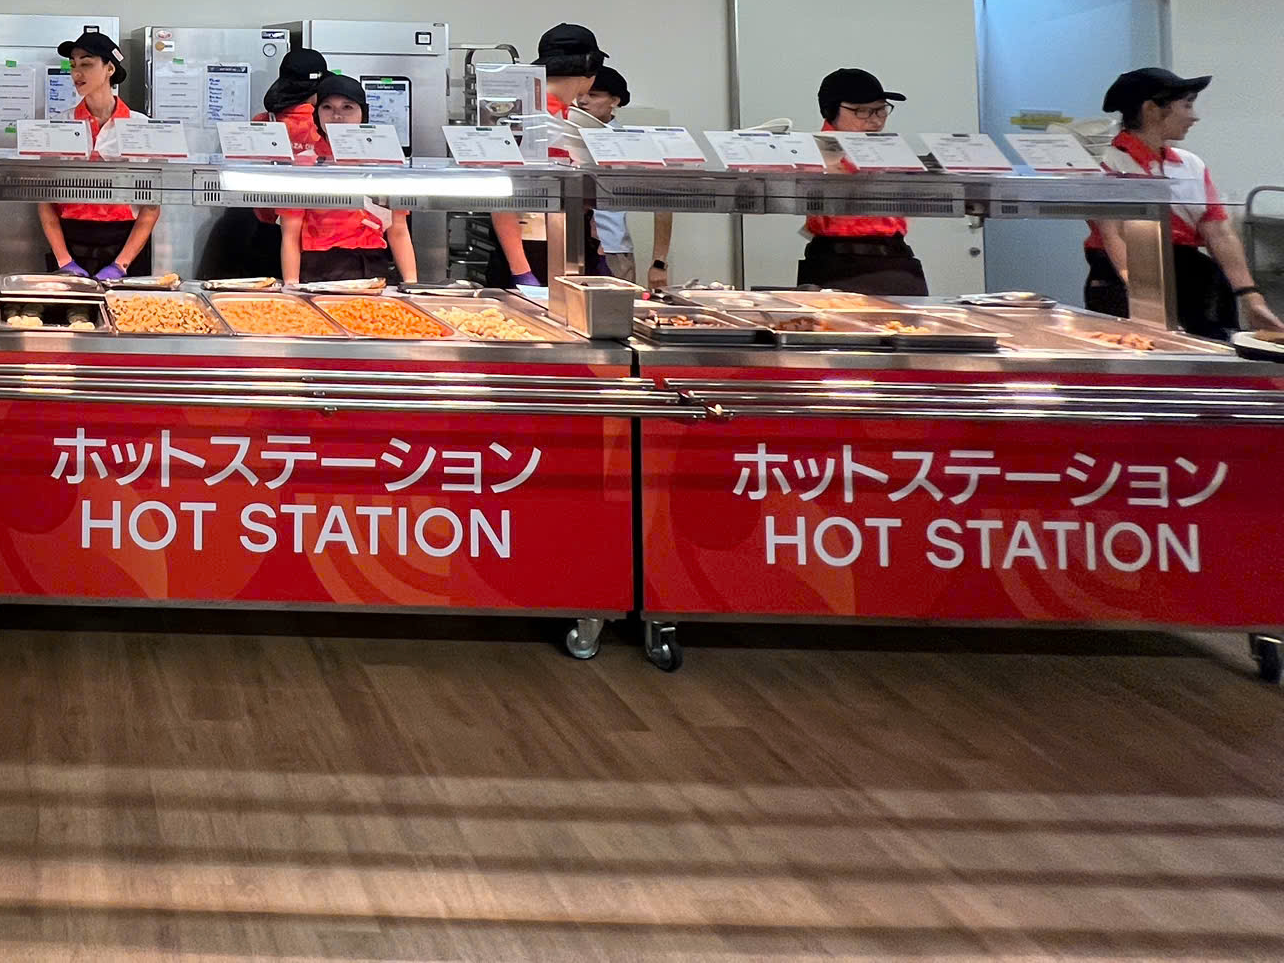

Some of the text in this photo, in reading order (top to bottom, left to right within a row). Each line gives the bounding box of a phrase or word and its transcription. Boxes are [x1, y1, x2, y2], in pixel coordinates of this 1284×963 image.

[50, 427, 543, 494] ホットステーション
[732, 442, 1229, 508] ホットステーション
[80, 499, 512, 559] HOT STATION
[764, 515, 1203, 574] HOT STATION
